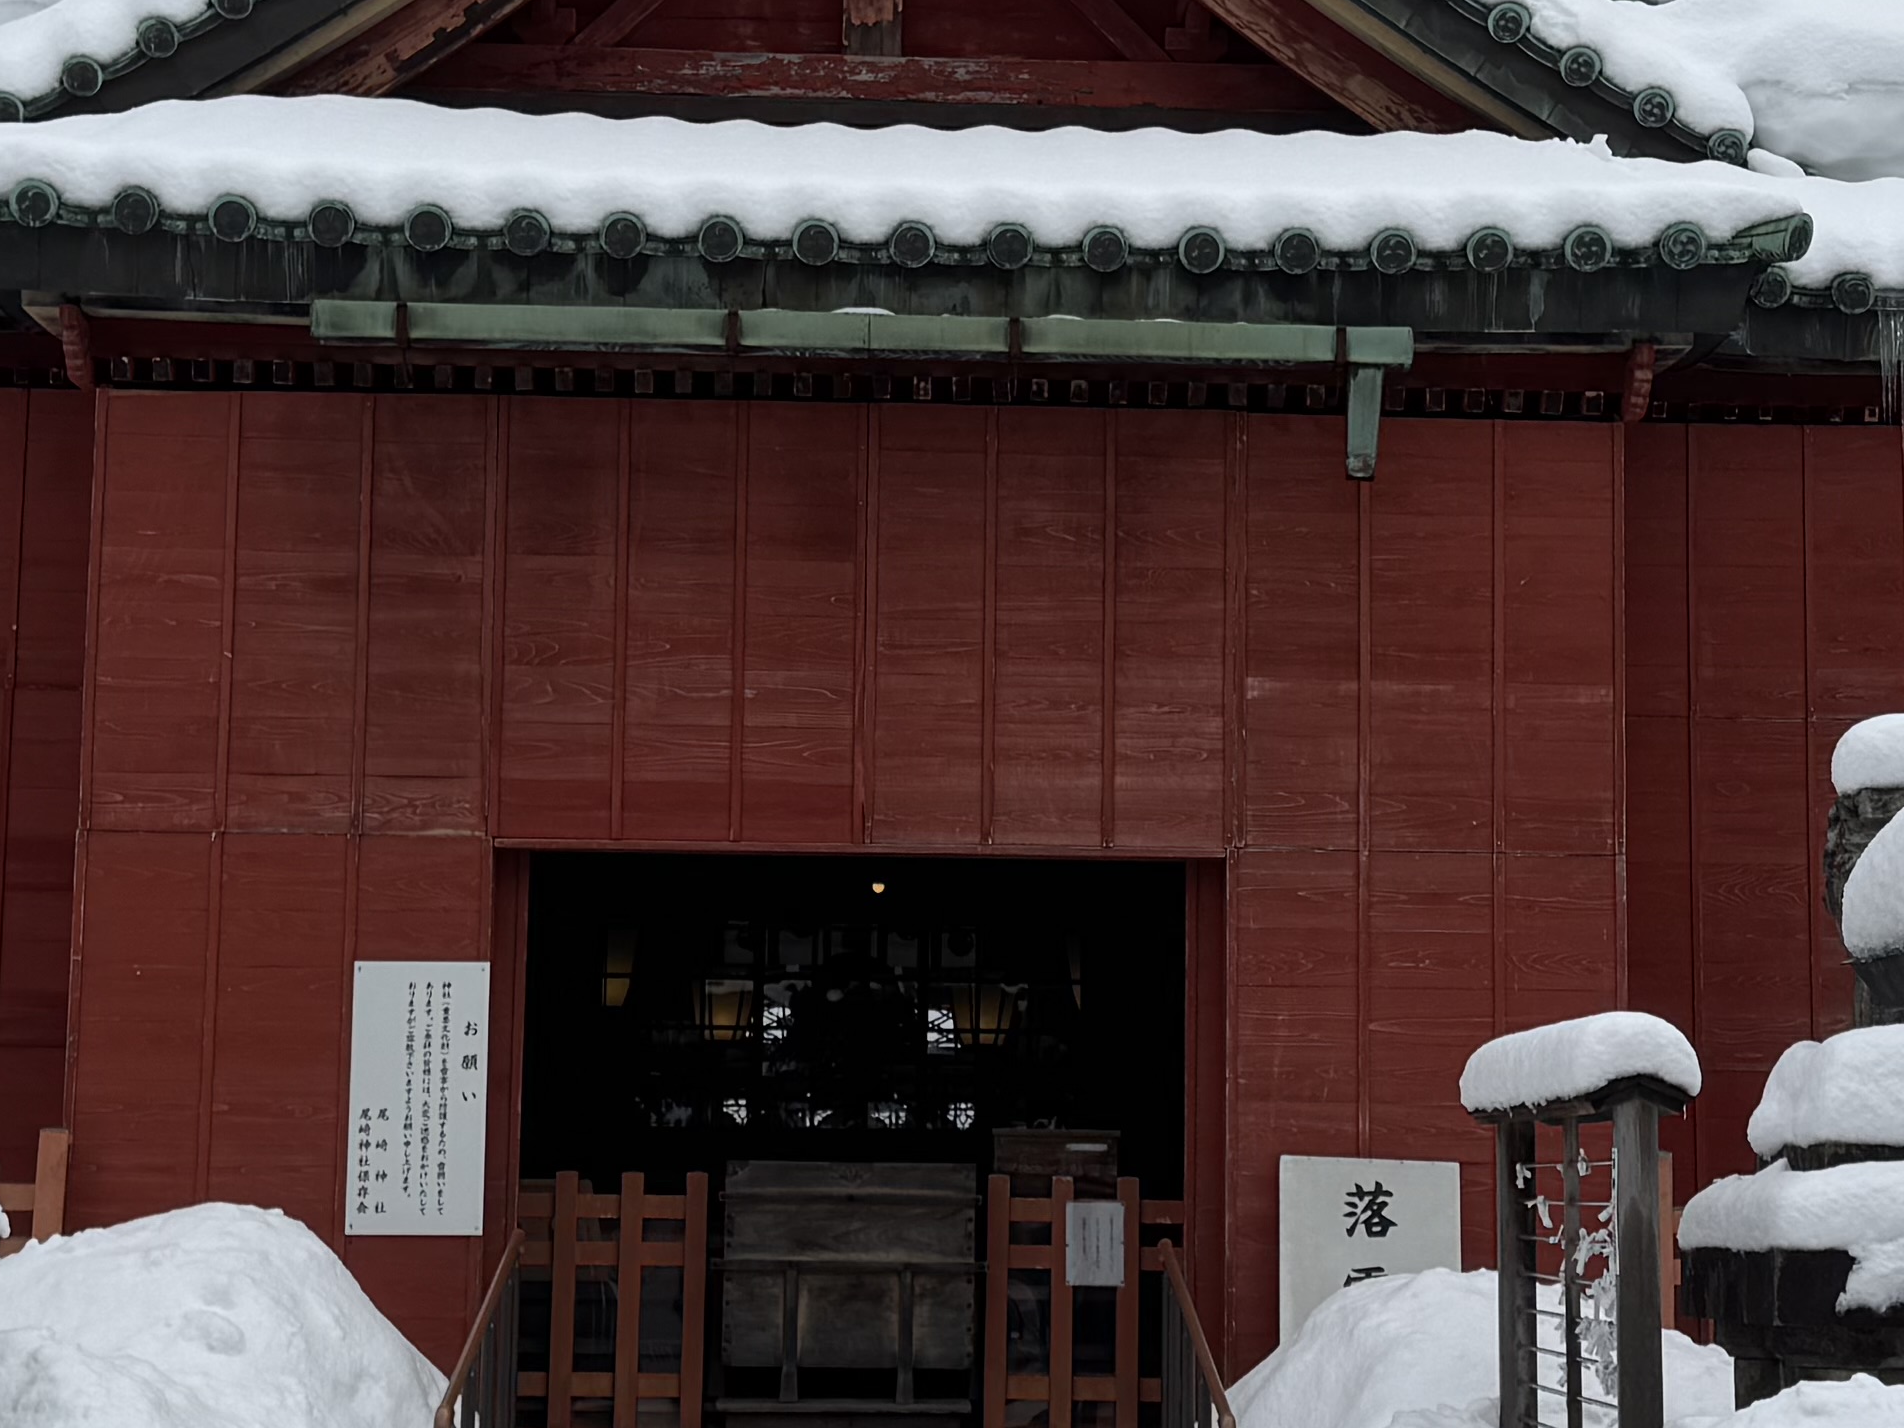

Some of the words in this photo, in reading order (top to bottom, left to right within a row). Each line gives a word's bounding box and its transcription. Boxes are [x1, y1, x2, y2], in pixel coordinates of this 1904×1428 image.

[461, 1020, 479, 1103] お願い
[356, 1107, 373, 1215] 尾崎神社保存会
[374, 1107, 390, 1215] 尾崎神社
